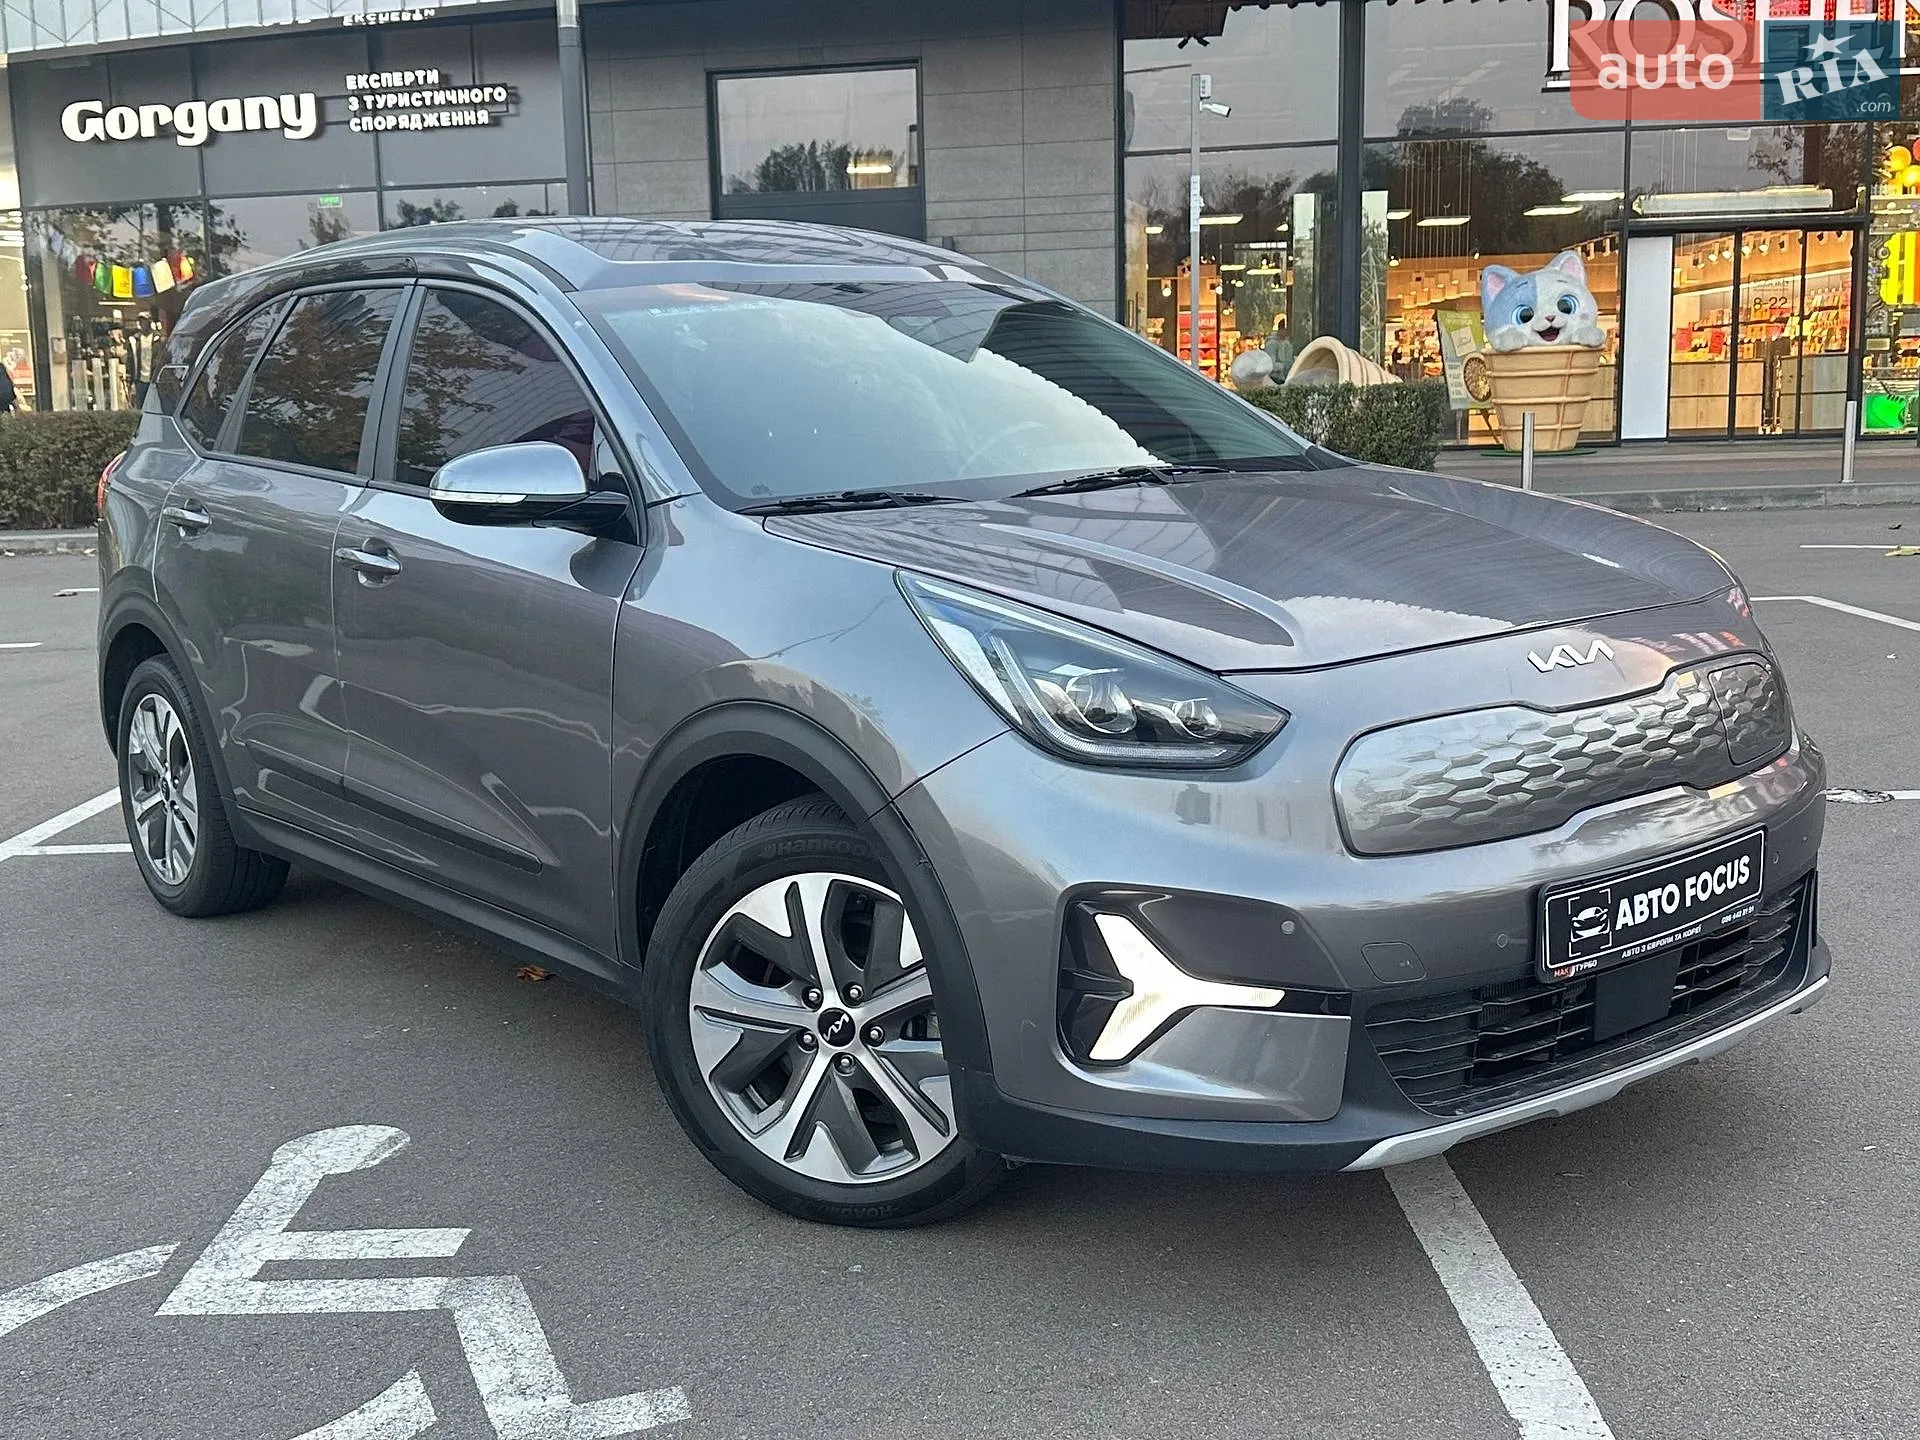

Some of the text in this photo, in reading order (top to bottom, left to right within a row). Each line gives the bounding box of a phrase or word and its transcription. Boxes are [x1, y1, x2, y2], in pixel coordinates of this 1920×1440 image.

[346, 69, 439, 90] ЕКСПЕРТИ
[363, 86, 508, 110] ТУРИСТИЧНОГО
[61, 92, 318, 147] Gorgany
[349, 109, 490, 133] СПОРЯДЖЕННЯ
[1753, 296, 1788, 311] 8-22
[1615, 855, 1751, 931] АВТО FOCUS
